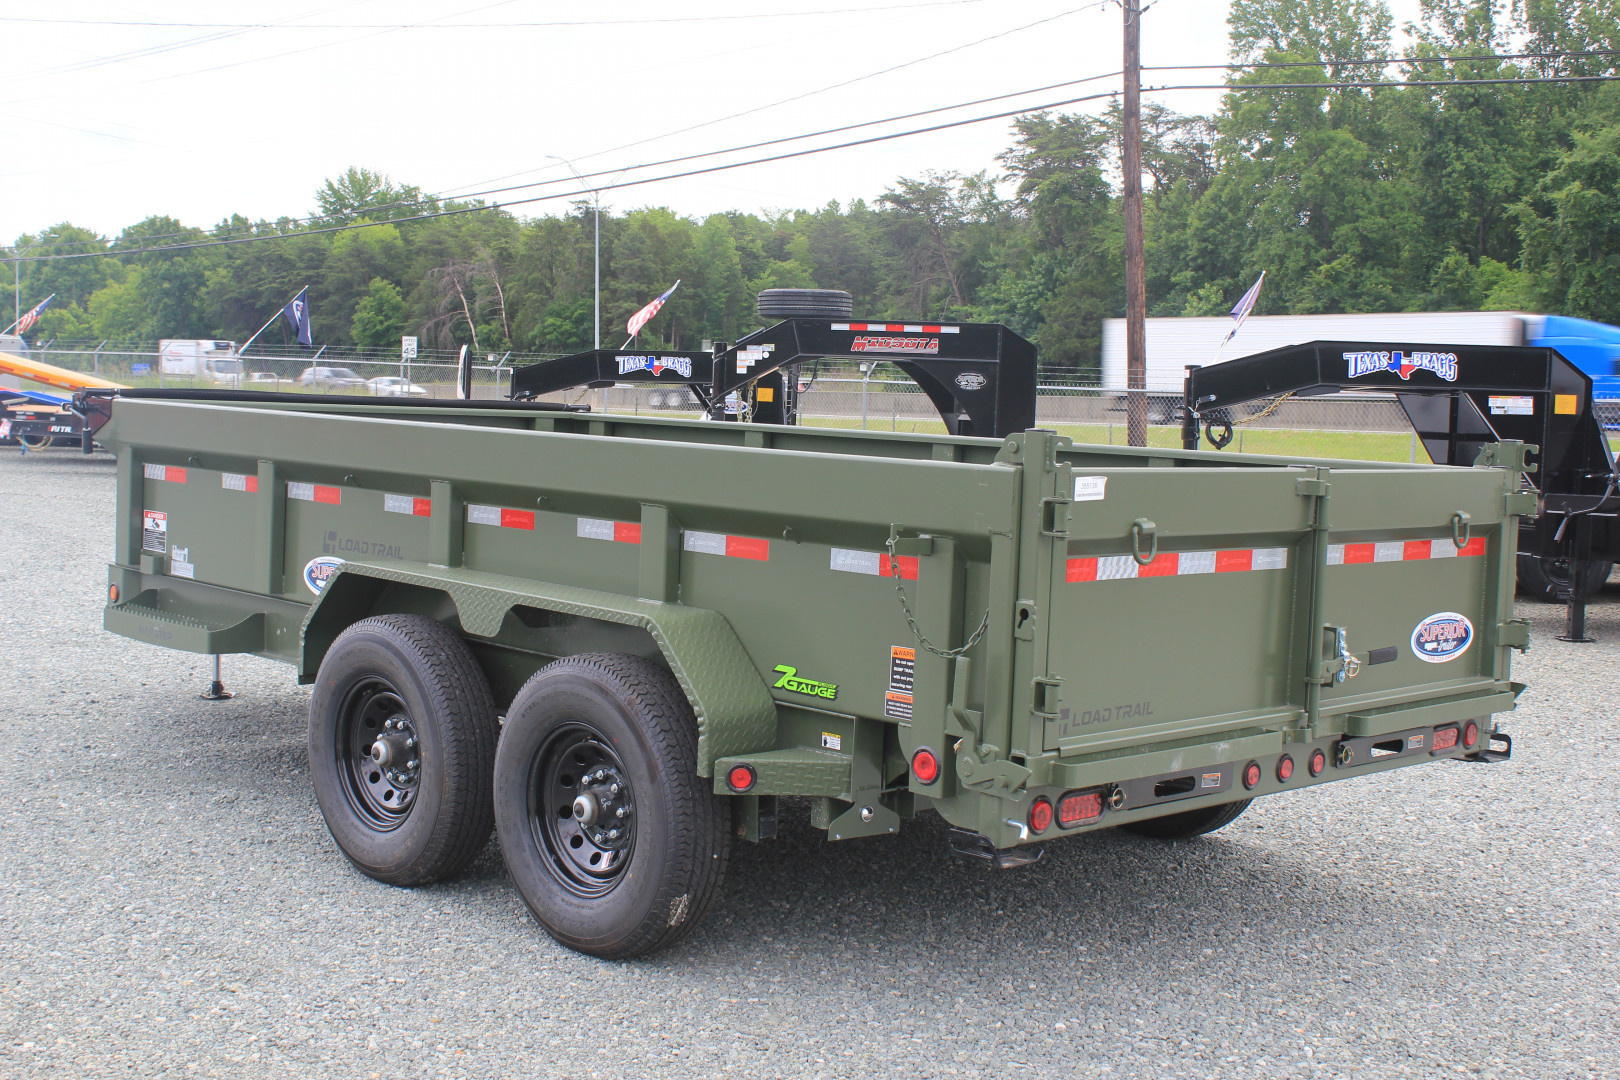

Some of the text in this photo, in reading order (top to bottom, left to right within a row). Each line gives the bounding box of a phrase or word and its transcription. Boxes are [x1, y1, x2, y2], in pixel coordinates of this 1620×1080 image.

[850, 336, 939, 353] MIDSOTA
[615, 356, 692, 378] TEXAS BRAGG
[1343, 351, 1458, 382] TEXAS BRAGG
[338, 537, 405, 560] LOAD TRAIL
[311, 560, 335, 580] SUPE
[1420, 617, 1467, 643] SUPERIOR
[898, 650, 914, 658] WARN
[772, 664, 838, 700] 7 GAUGE
[1071, 701, 1155, 728] LOAD TRAIL
